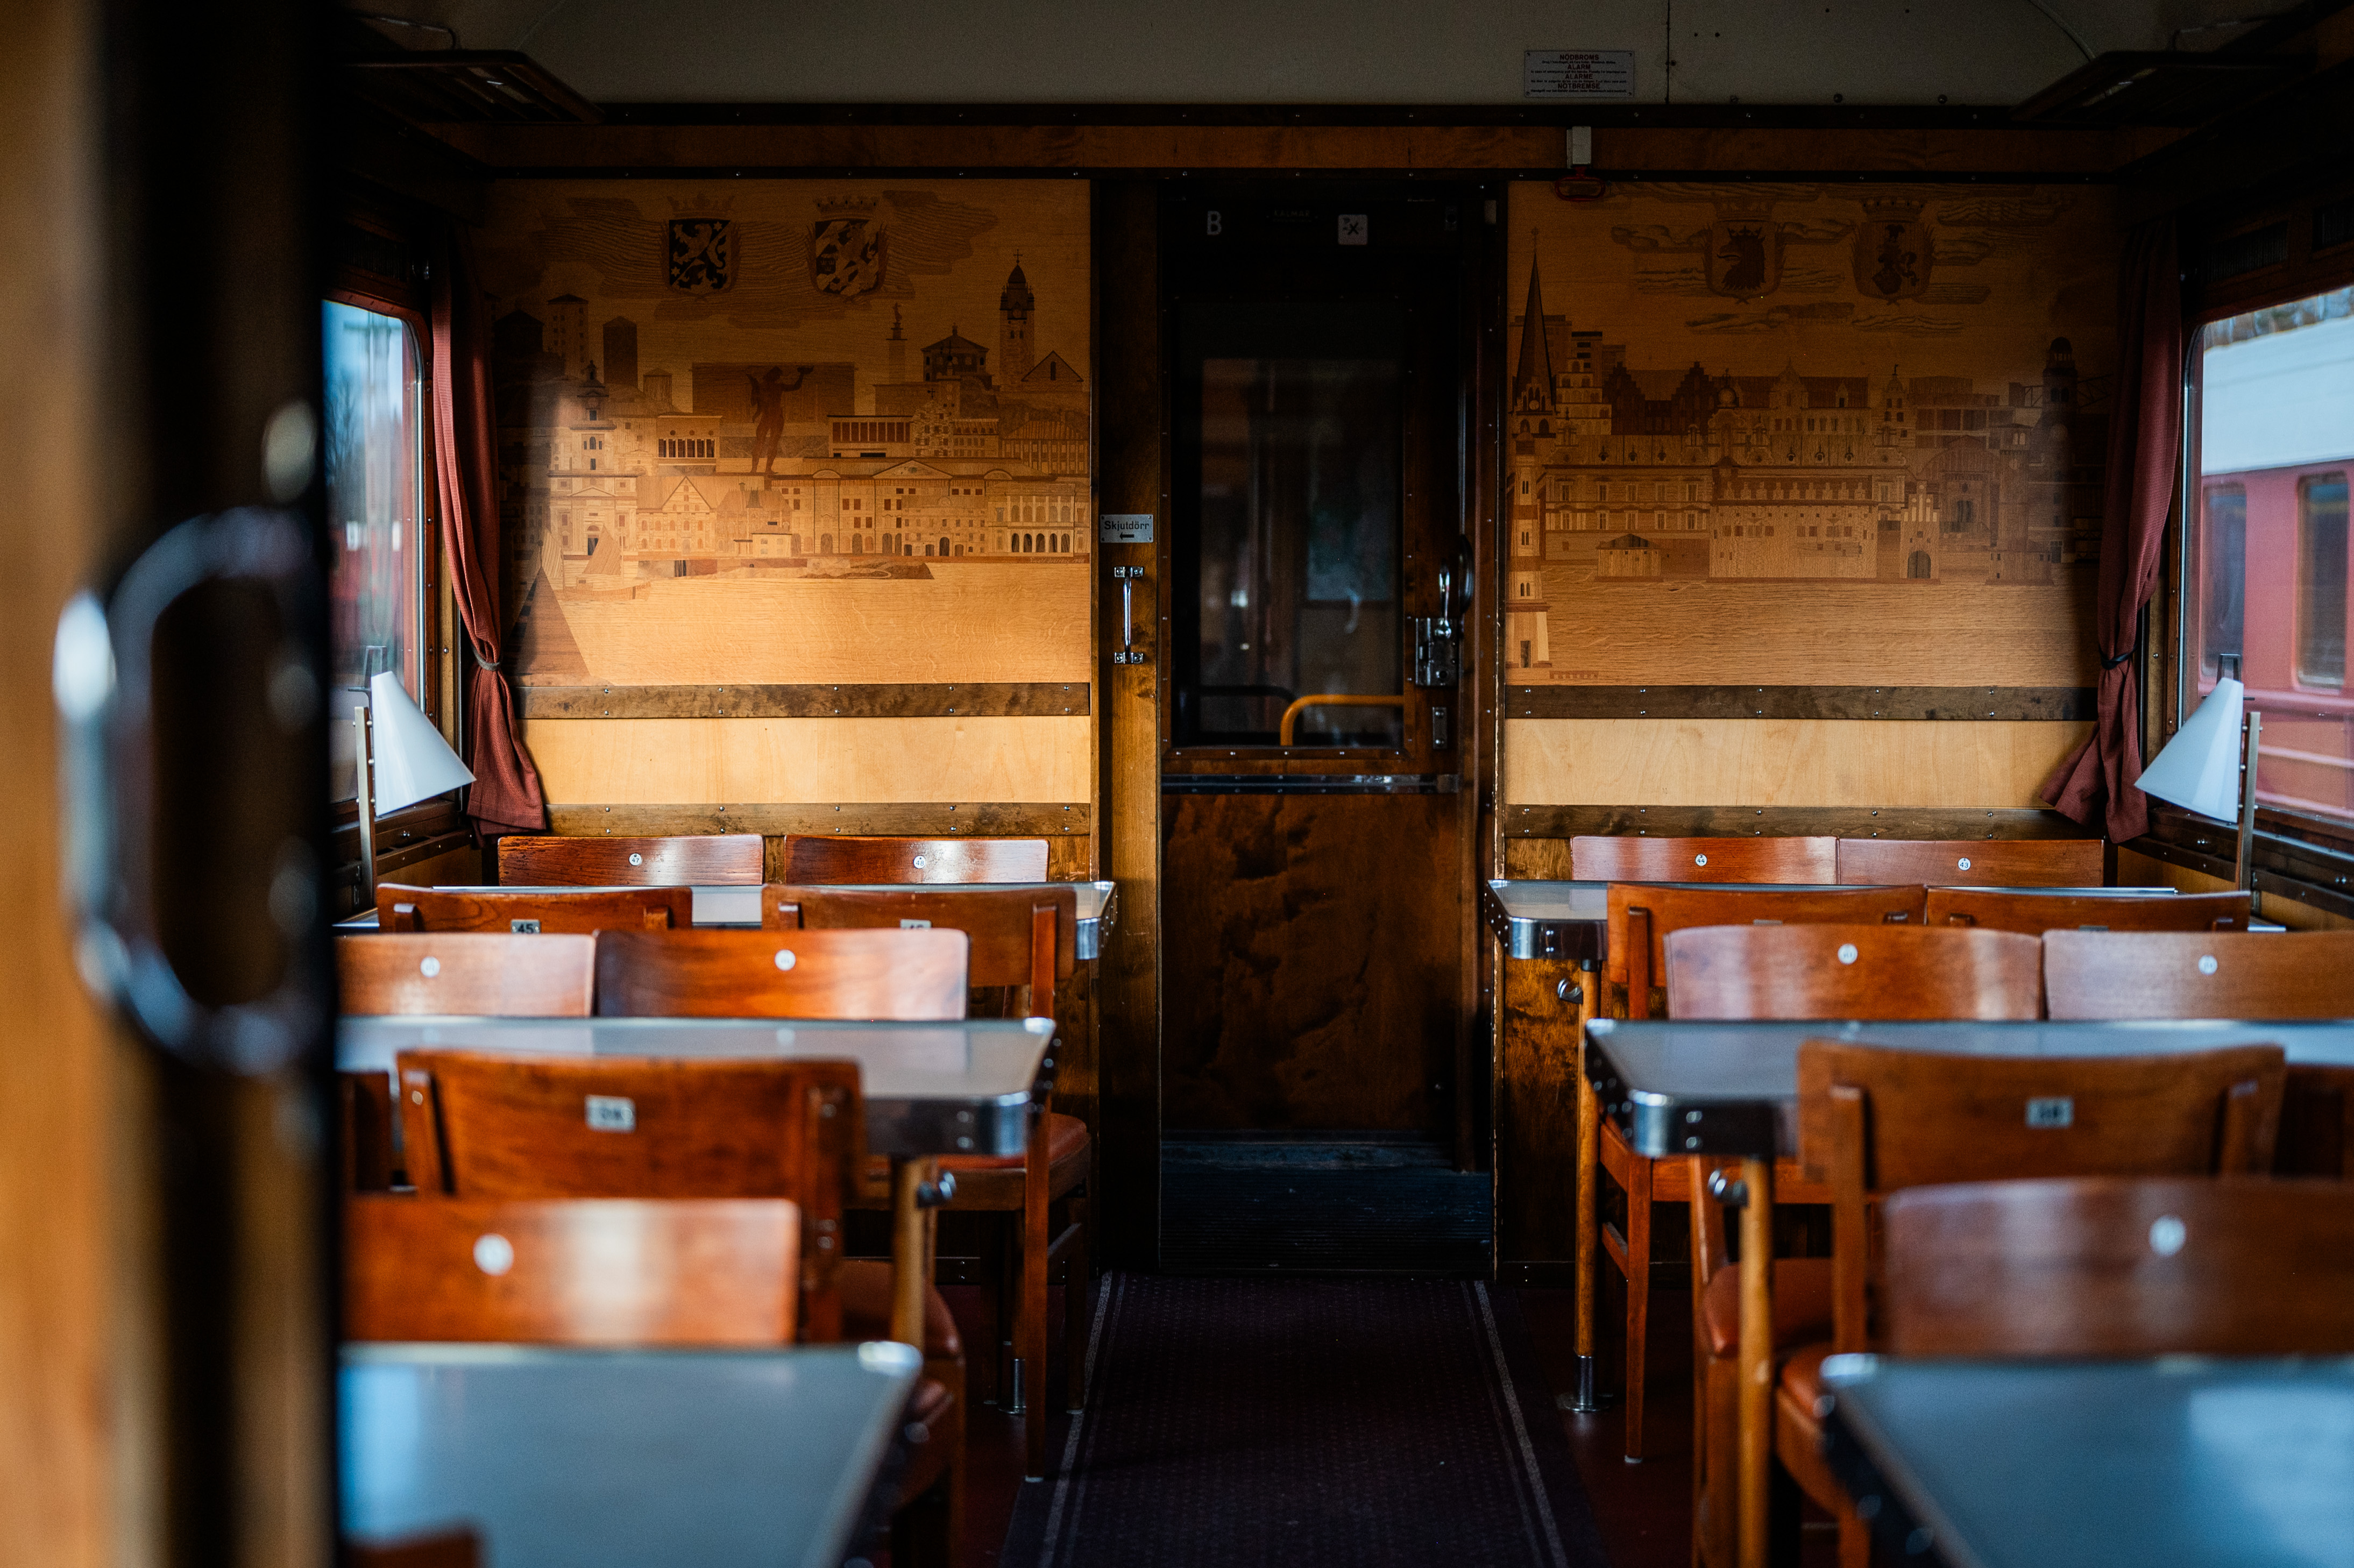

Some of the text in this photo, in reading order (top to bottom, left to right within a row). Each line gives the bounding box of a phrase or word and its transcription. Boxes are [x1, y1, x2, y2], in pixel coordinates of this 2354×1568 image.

[1207, 211, 1222, 235] B
[1104, 521, 1149, 531] Skjutdörr
[517, 924, 534, 934] 45
